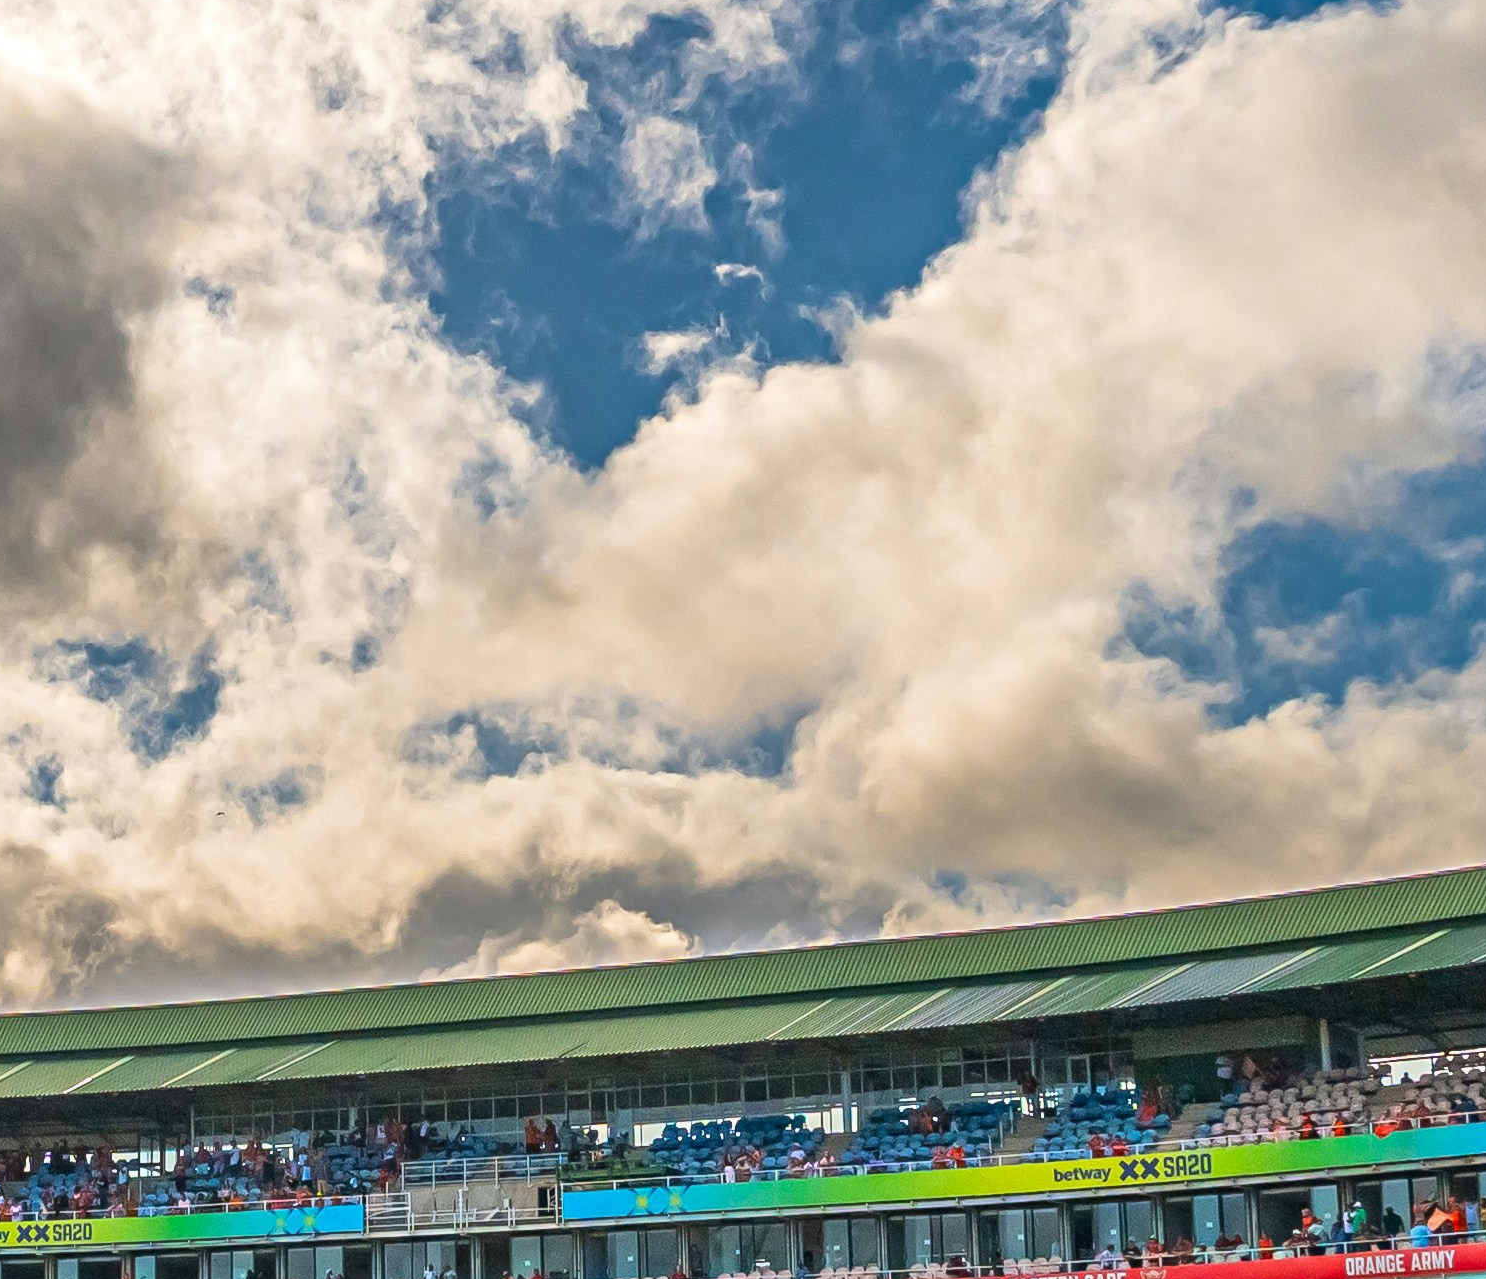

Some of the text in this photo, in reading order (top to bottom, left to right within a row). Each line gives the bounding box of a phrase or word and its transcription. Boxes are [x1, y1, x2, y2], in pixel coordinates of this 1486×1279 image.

[1053, 1167, 1111, 1182] betway
[1163, 1153, 1211, 1177] SA20
[53, 1223, 92, 1242] SA20
[1345, 1249, 1455, 1276] ORANGE ARMY
